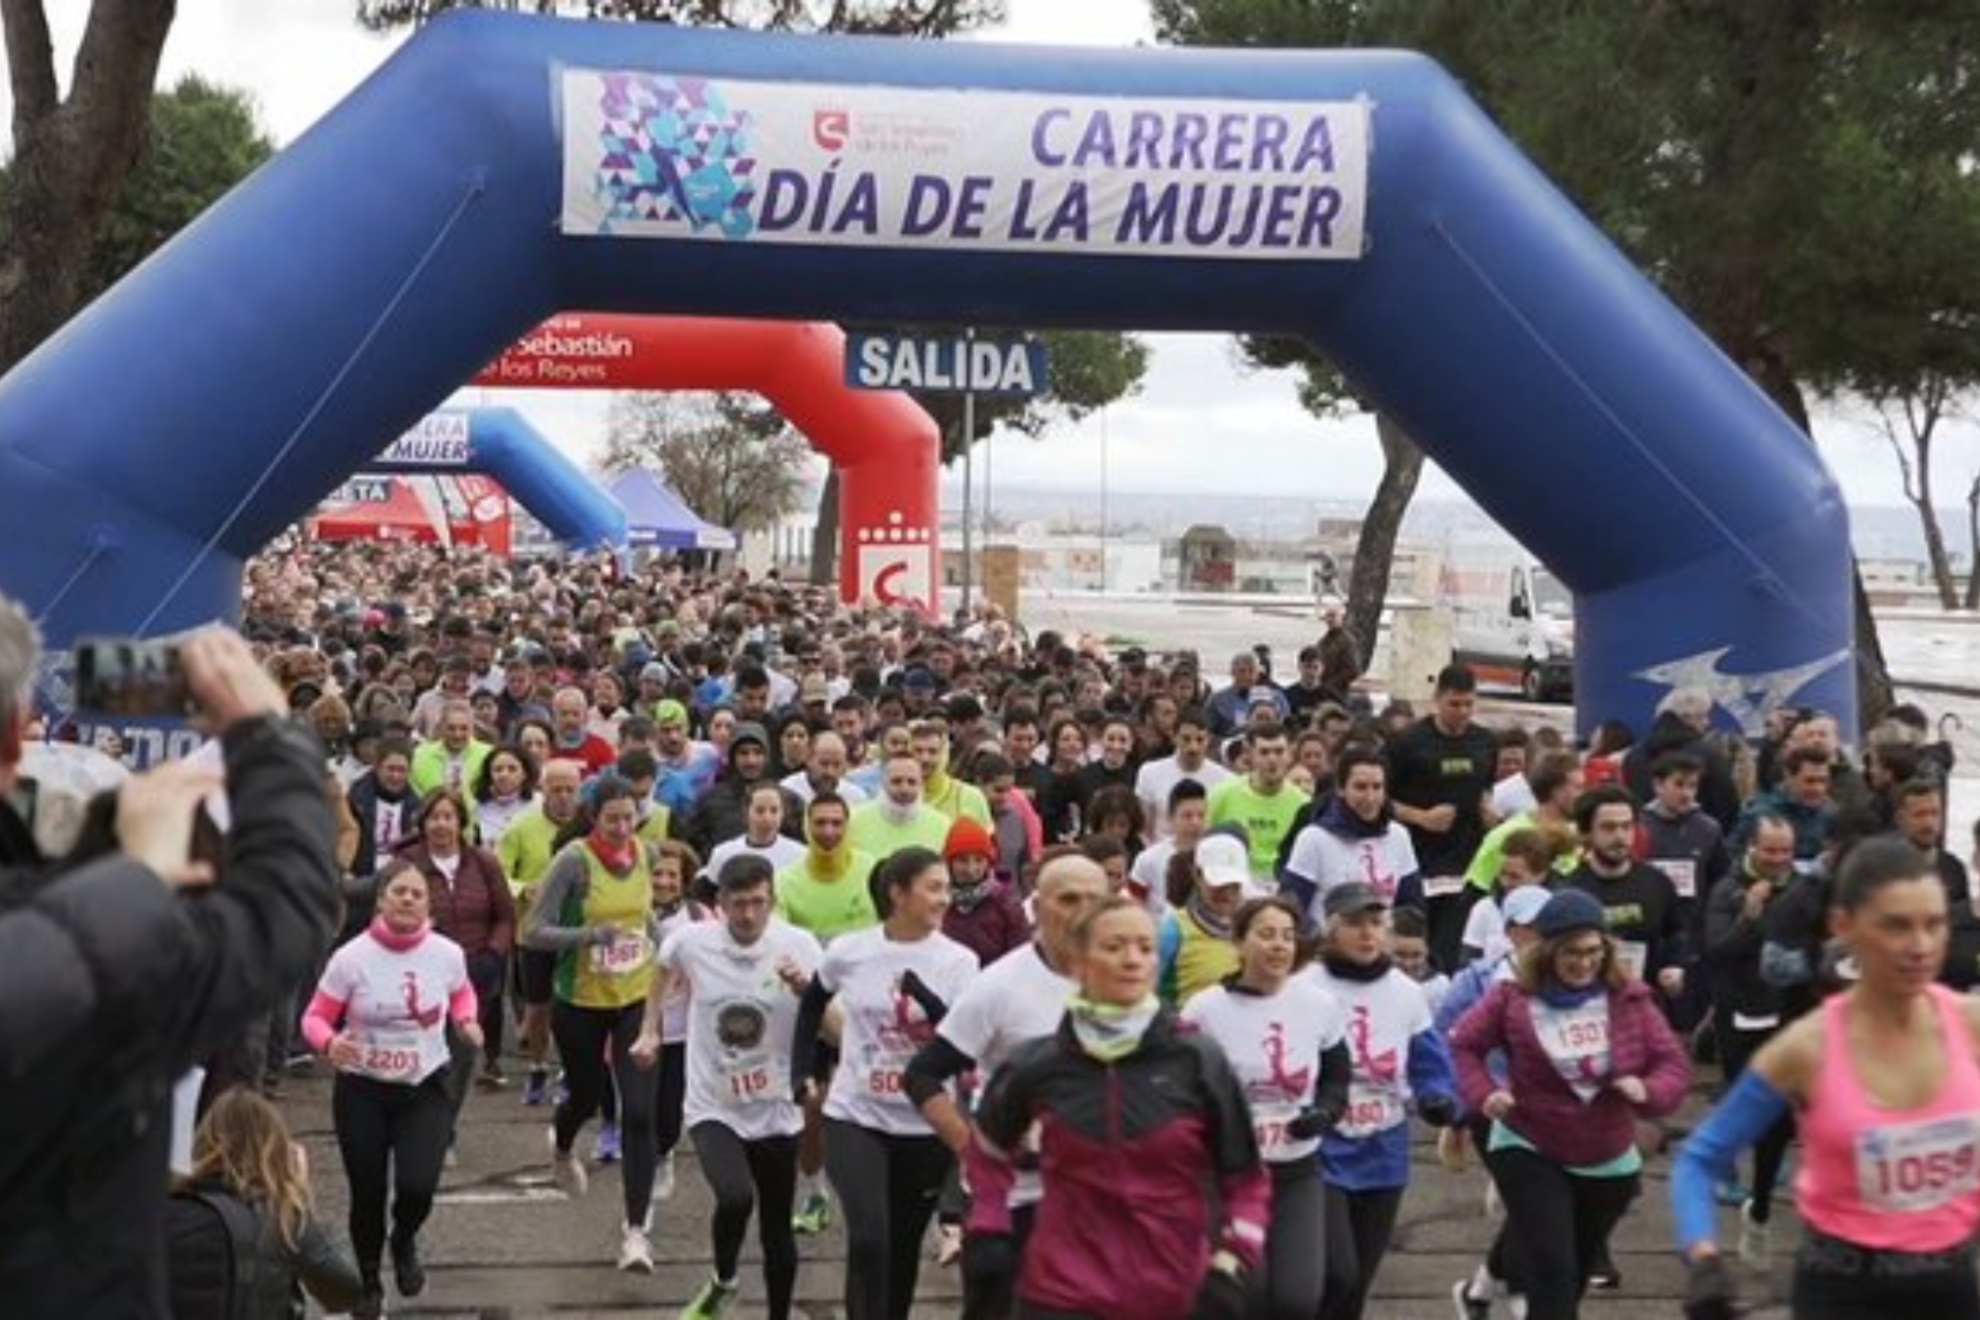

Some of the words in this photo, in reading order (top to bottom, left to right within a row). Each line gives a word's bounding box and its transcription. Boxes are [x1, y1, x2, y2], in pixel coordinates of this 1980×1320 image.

[1031, 108, 1335, 172] CARRERA
[757, 158, 878, 234] DÍA
[900, 174, 994, 238] DE
[1007, 179, 1088, 242] LA
[1114, 181, 1343, 247] MUJER
[500, 358, 532, 377] los
[538, 359, 607, 380] Reyes
[858, 336, 1034, 391] SALIDA
